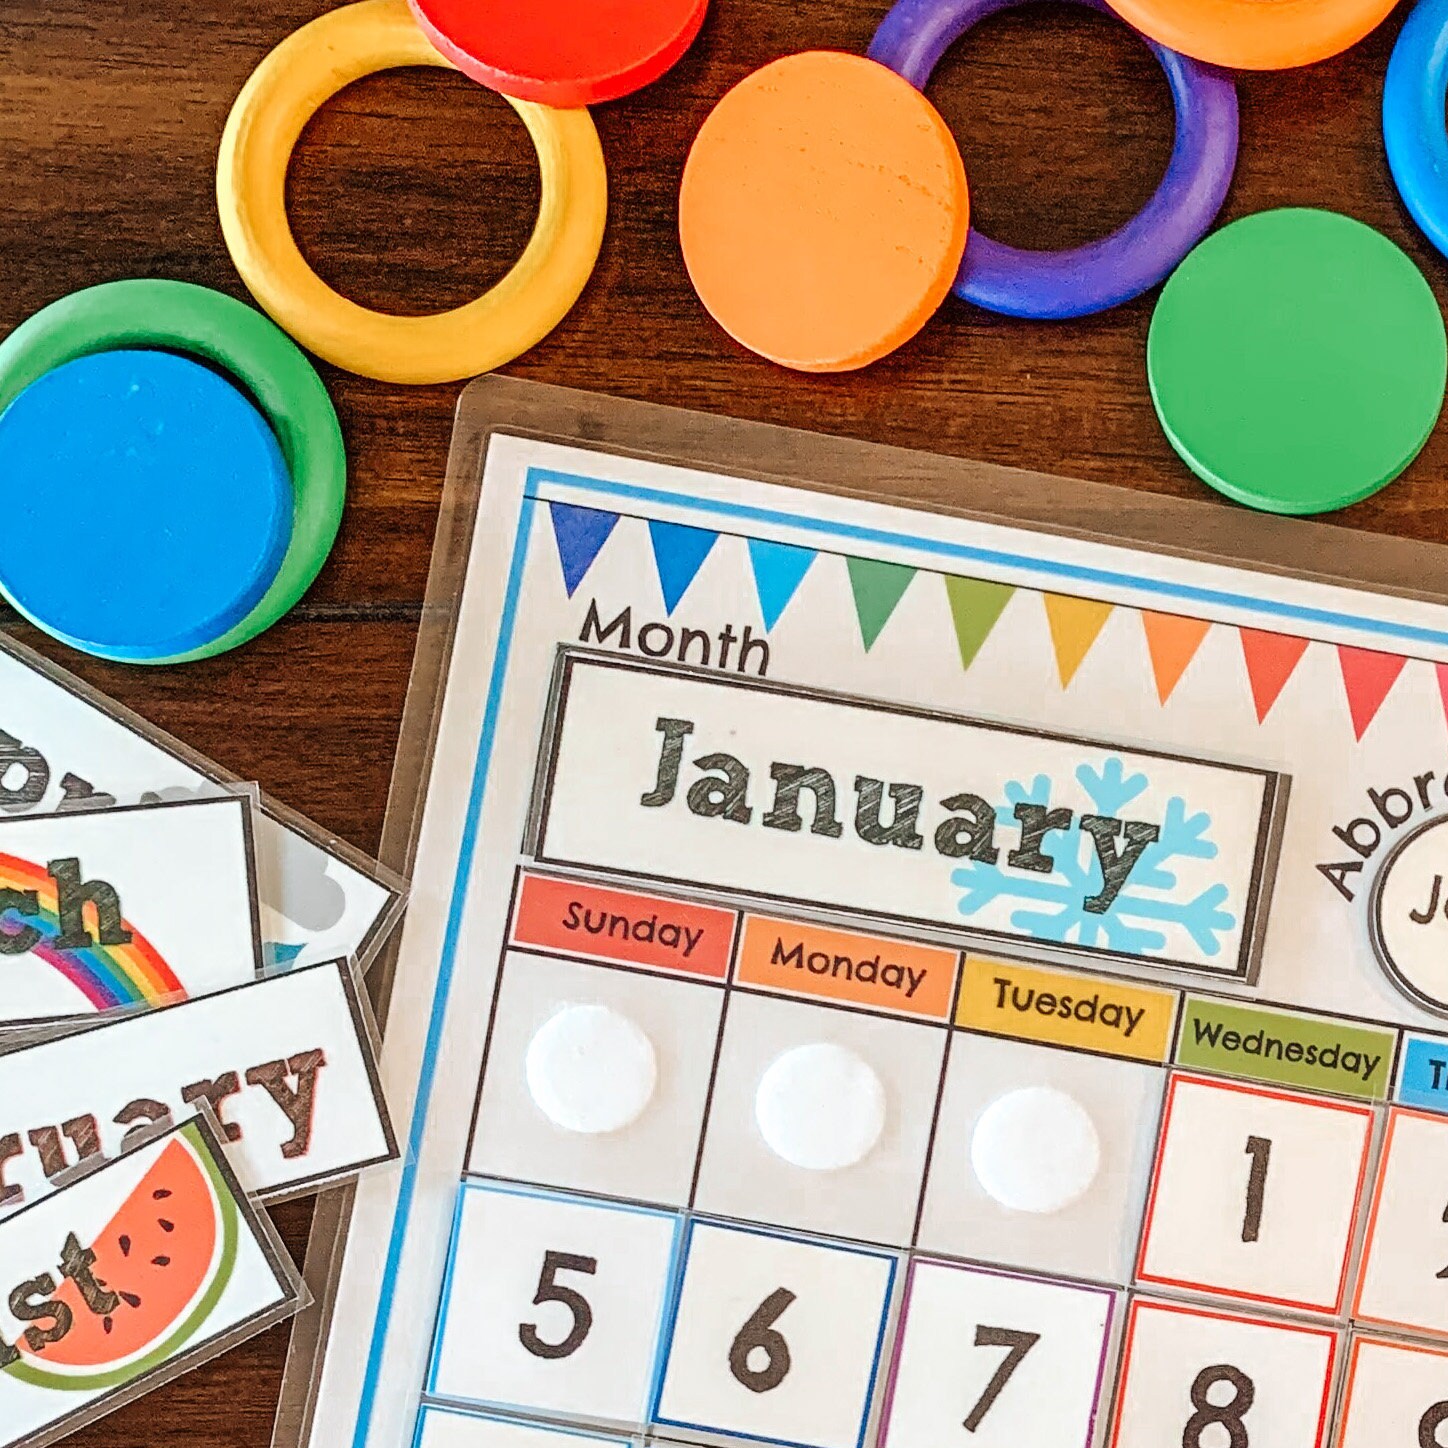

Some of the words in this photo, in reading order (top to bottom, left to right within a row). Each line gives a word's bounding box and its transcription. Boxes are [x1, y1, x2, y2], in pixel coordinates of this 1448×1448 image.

[578, 596, 771, 677] Month
[640, 717, 1161, 915] January
[561, 900, 705, 958] Sunday
[771, 937, 927, 997] Monday
[992, 977, 1146, 1037] Tuesday
[1191, 1018, 1382, 1081] Wednesday
[1241, 1135, 1272, 1243] 1
[519, 1250, 597, 1359] 5
[728, 1287, 797, 1393] 6
[963, 1324, 1041, 1433] 7
